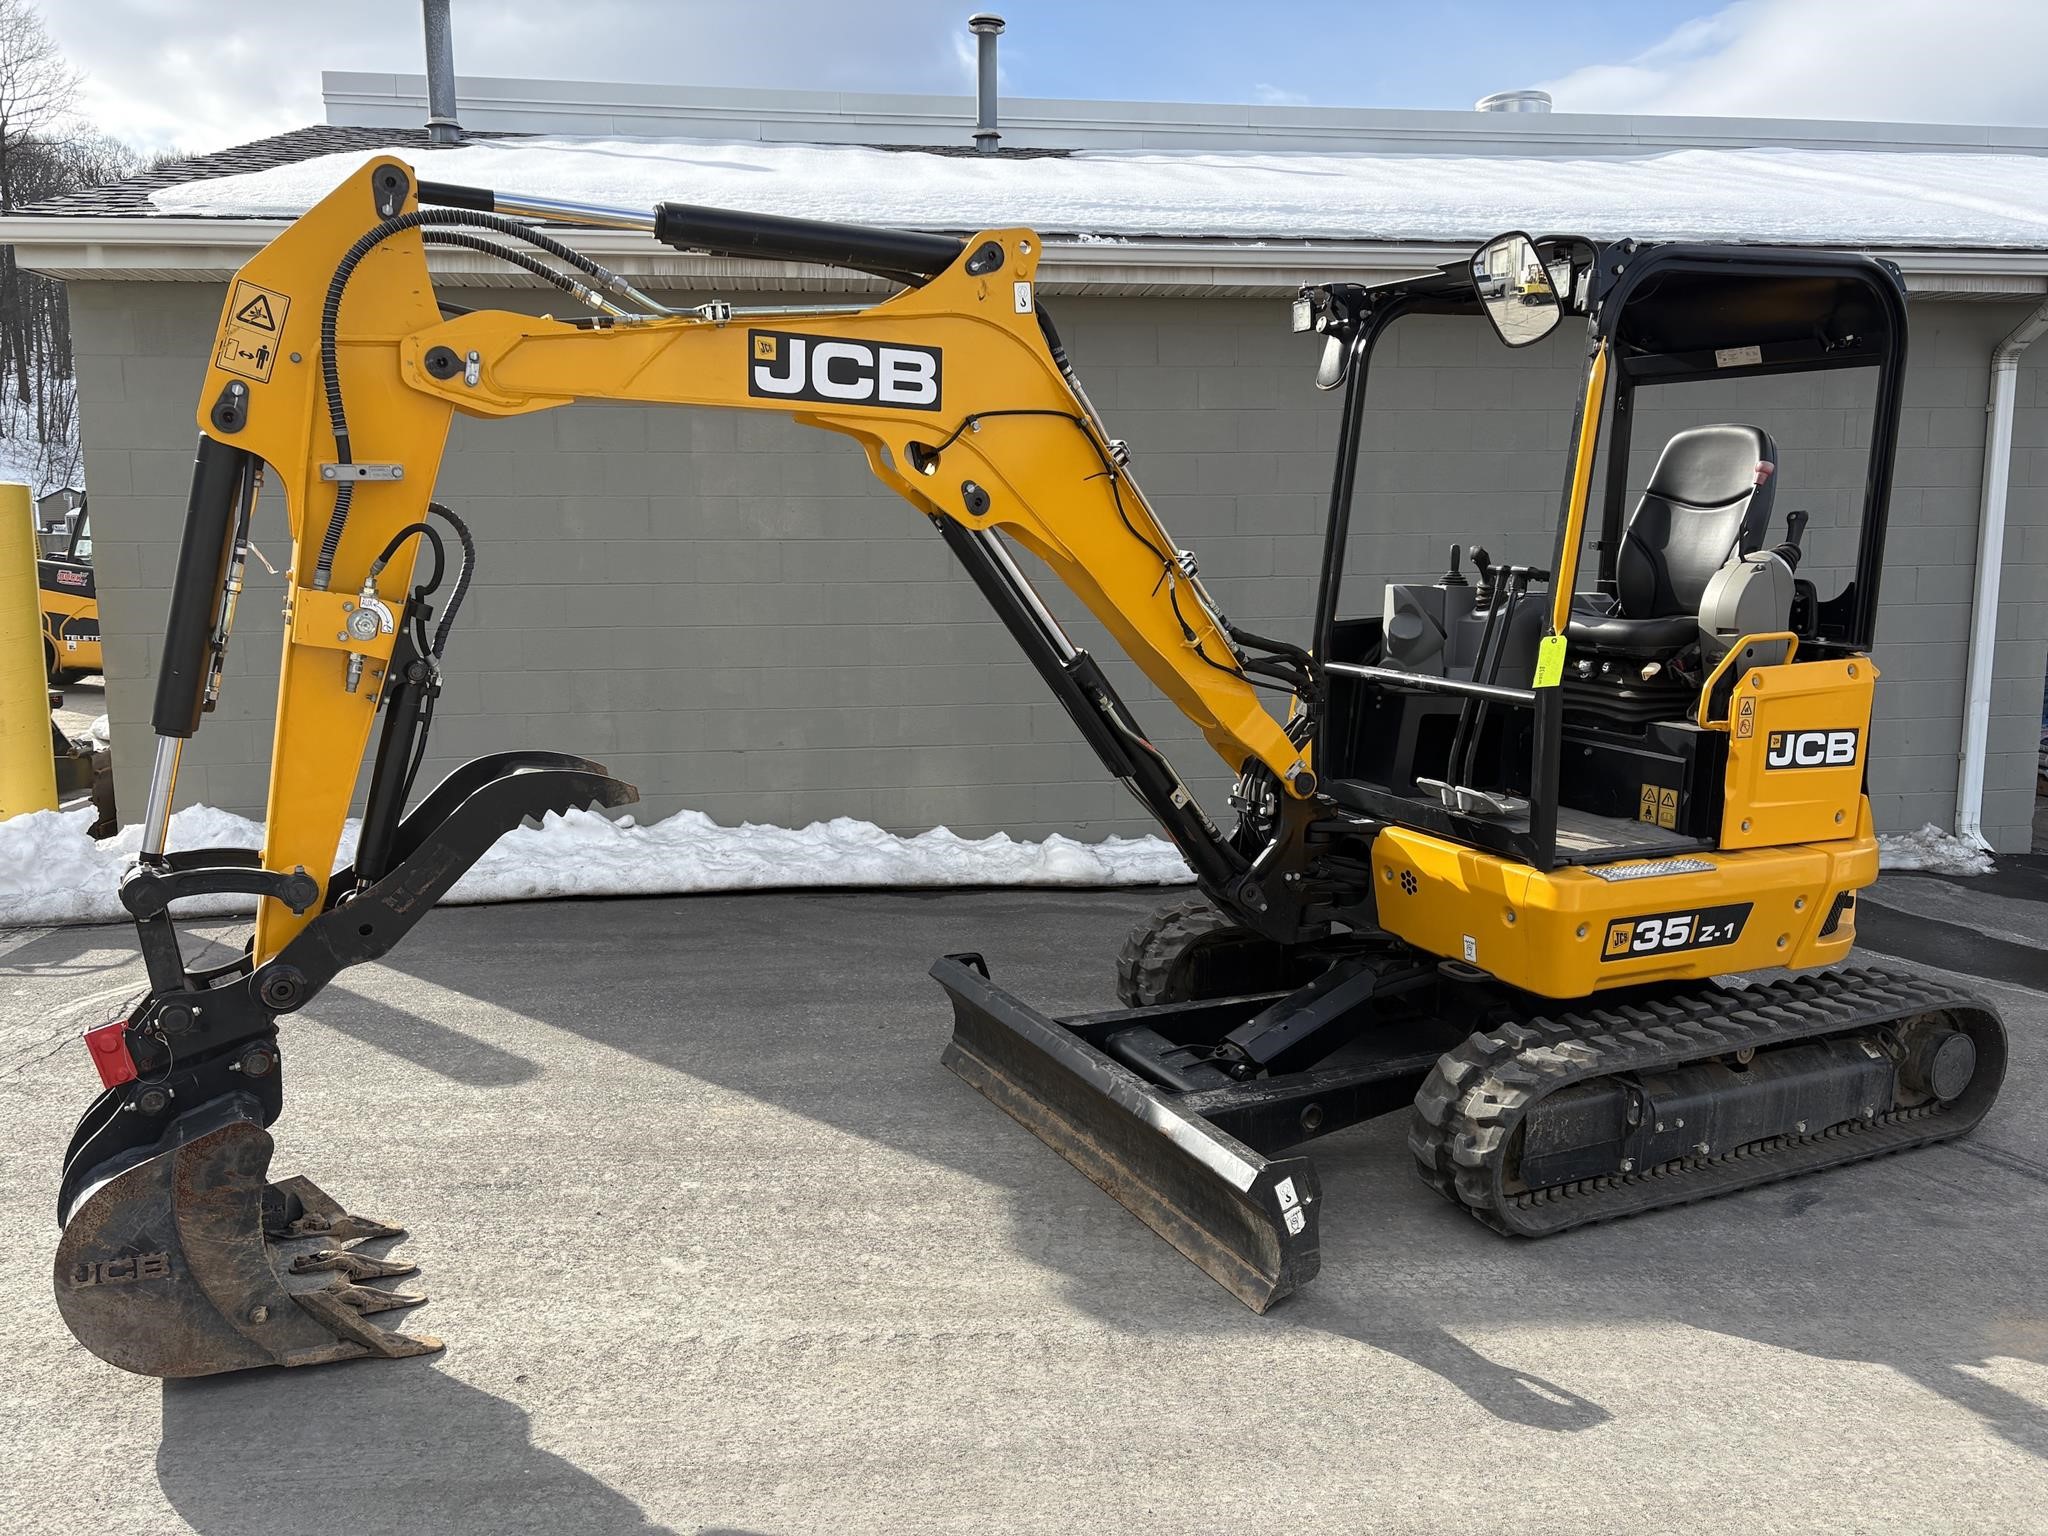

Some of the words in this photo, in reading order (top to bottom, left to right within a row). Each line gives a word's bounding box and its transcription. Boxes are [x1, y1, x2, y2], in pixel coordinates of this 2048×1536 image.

[759, 341, 773, 354] JCB
[755, 339, 937, 405] JCB
[1769, 732, 1856, 766] JCB
[1613, 931, 1629, 948] JCB
[1633, 916, 1692, 951] 35
[70, 1252, 169, 1288] JCB
